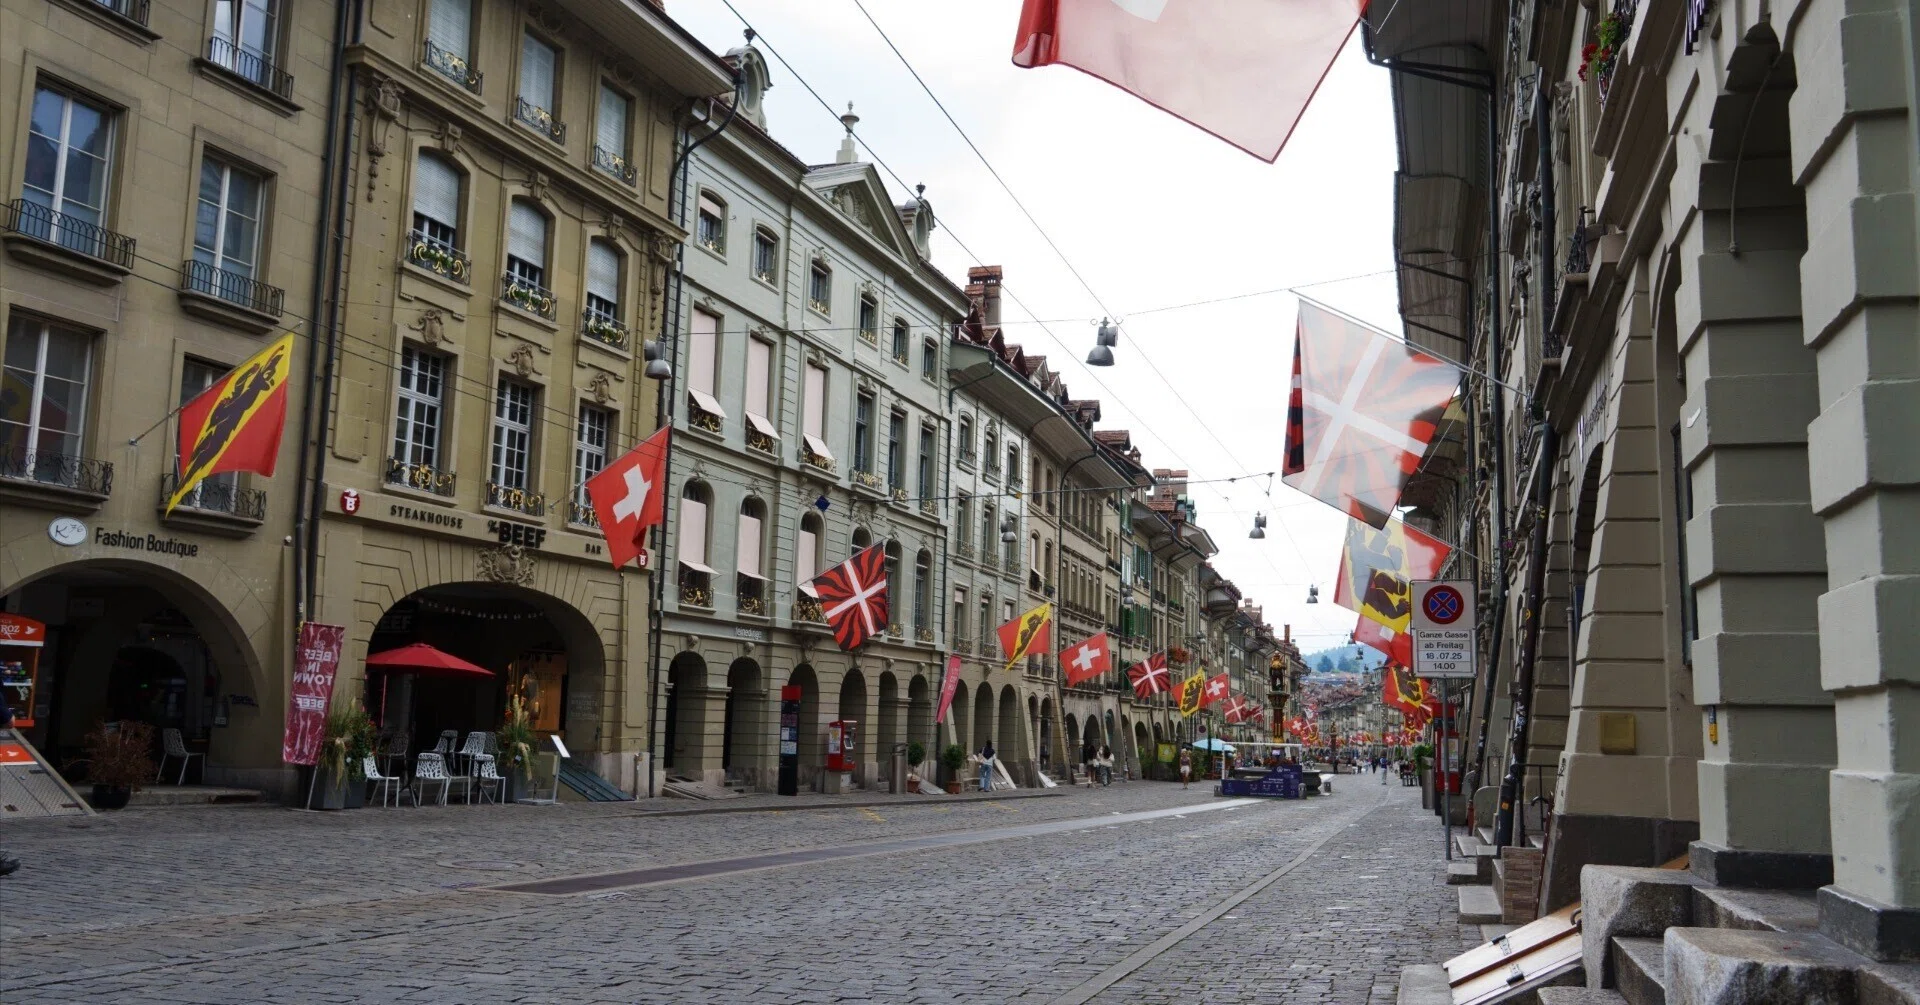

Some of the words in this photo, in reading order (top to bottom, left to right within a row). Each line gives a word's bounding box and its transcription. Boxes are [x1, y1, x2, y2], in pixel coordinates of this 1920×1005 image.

[390, 504, 463, 529] STEAKHOUSE
[498, 521, 547, 549] BEEF
[95, 527, 144, 550] Fashion
[147, 534, 198, 557] Boutique
[585, 543, 602, 555] BAR
[1419, 631, 1442, 639] Ganze
[1444, 631, 1468, 639] Gasse
[1424, 641, 1434, 649] ab
[1436, 641, 1464, 650] Freitag
[1433, 662, 1456, 670] 14.00
